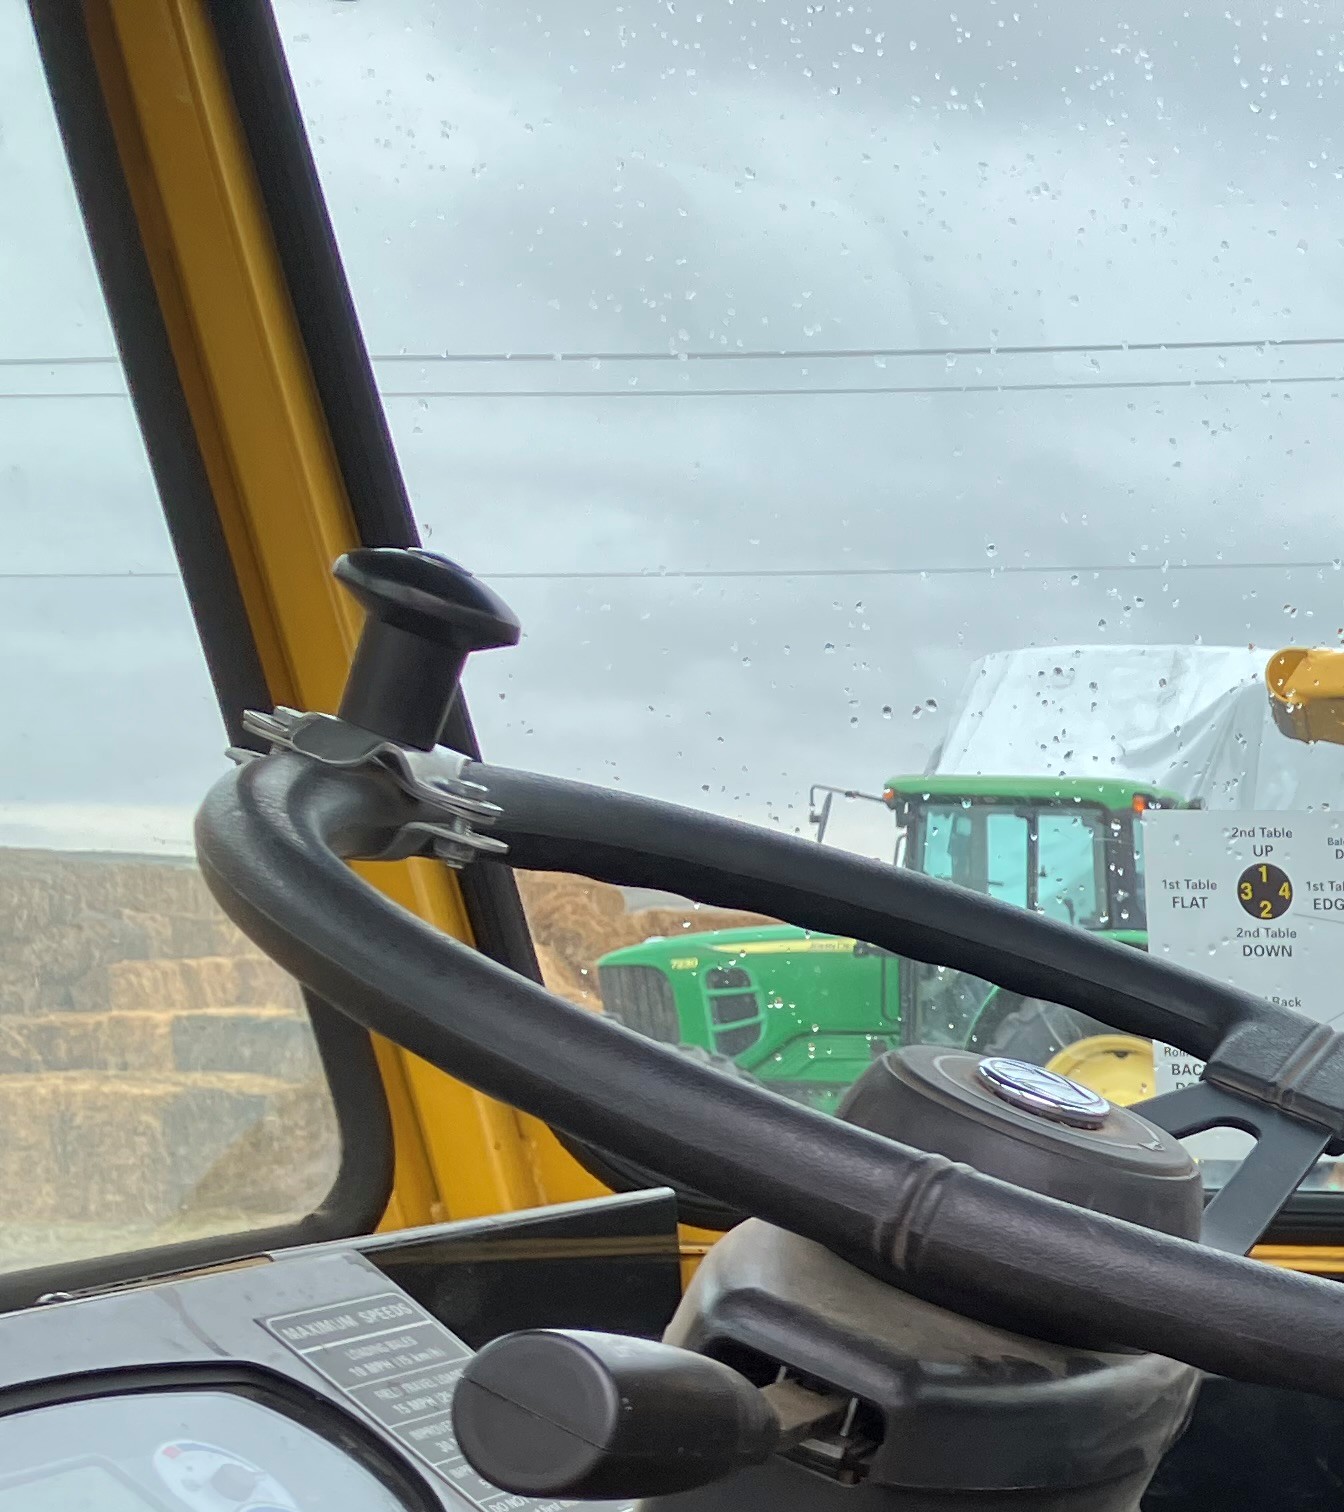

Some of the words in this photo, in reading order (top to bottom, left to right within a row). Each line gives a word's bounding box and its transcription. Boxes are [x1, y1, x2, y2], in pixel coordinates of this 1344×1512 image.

[1231, 827, 1255, 839] 2nd
[1260, 826, 1293, 839] Table
[1252, 844, 1274, 857] UP
[1258, 865, 1268, 883] 1
[1162, 879, 1180, 890] 1st
[1184, 879, 1218, 891] Table
[1240, 882, 1253, 901] 3
[1278, 882, 1291, 900] 4
[1306, 880, 1324, 892] 1st
[1172, 896, 1208, 909] FLAT
[1259, 900, 1273, 918] 2
[1236, 927, 1260, 939] 2nd
[1264, 927, 1297, 939] Table
[1242, 945, 1293, 957] DOWN
[1171, 1064, 1207, 1076] BAC
[282, 1314, 359, 1340] MAXIMUM
[358, 1303, 413, 1324] SPEEDS
